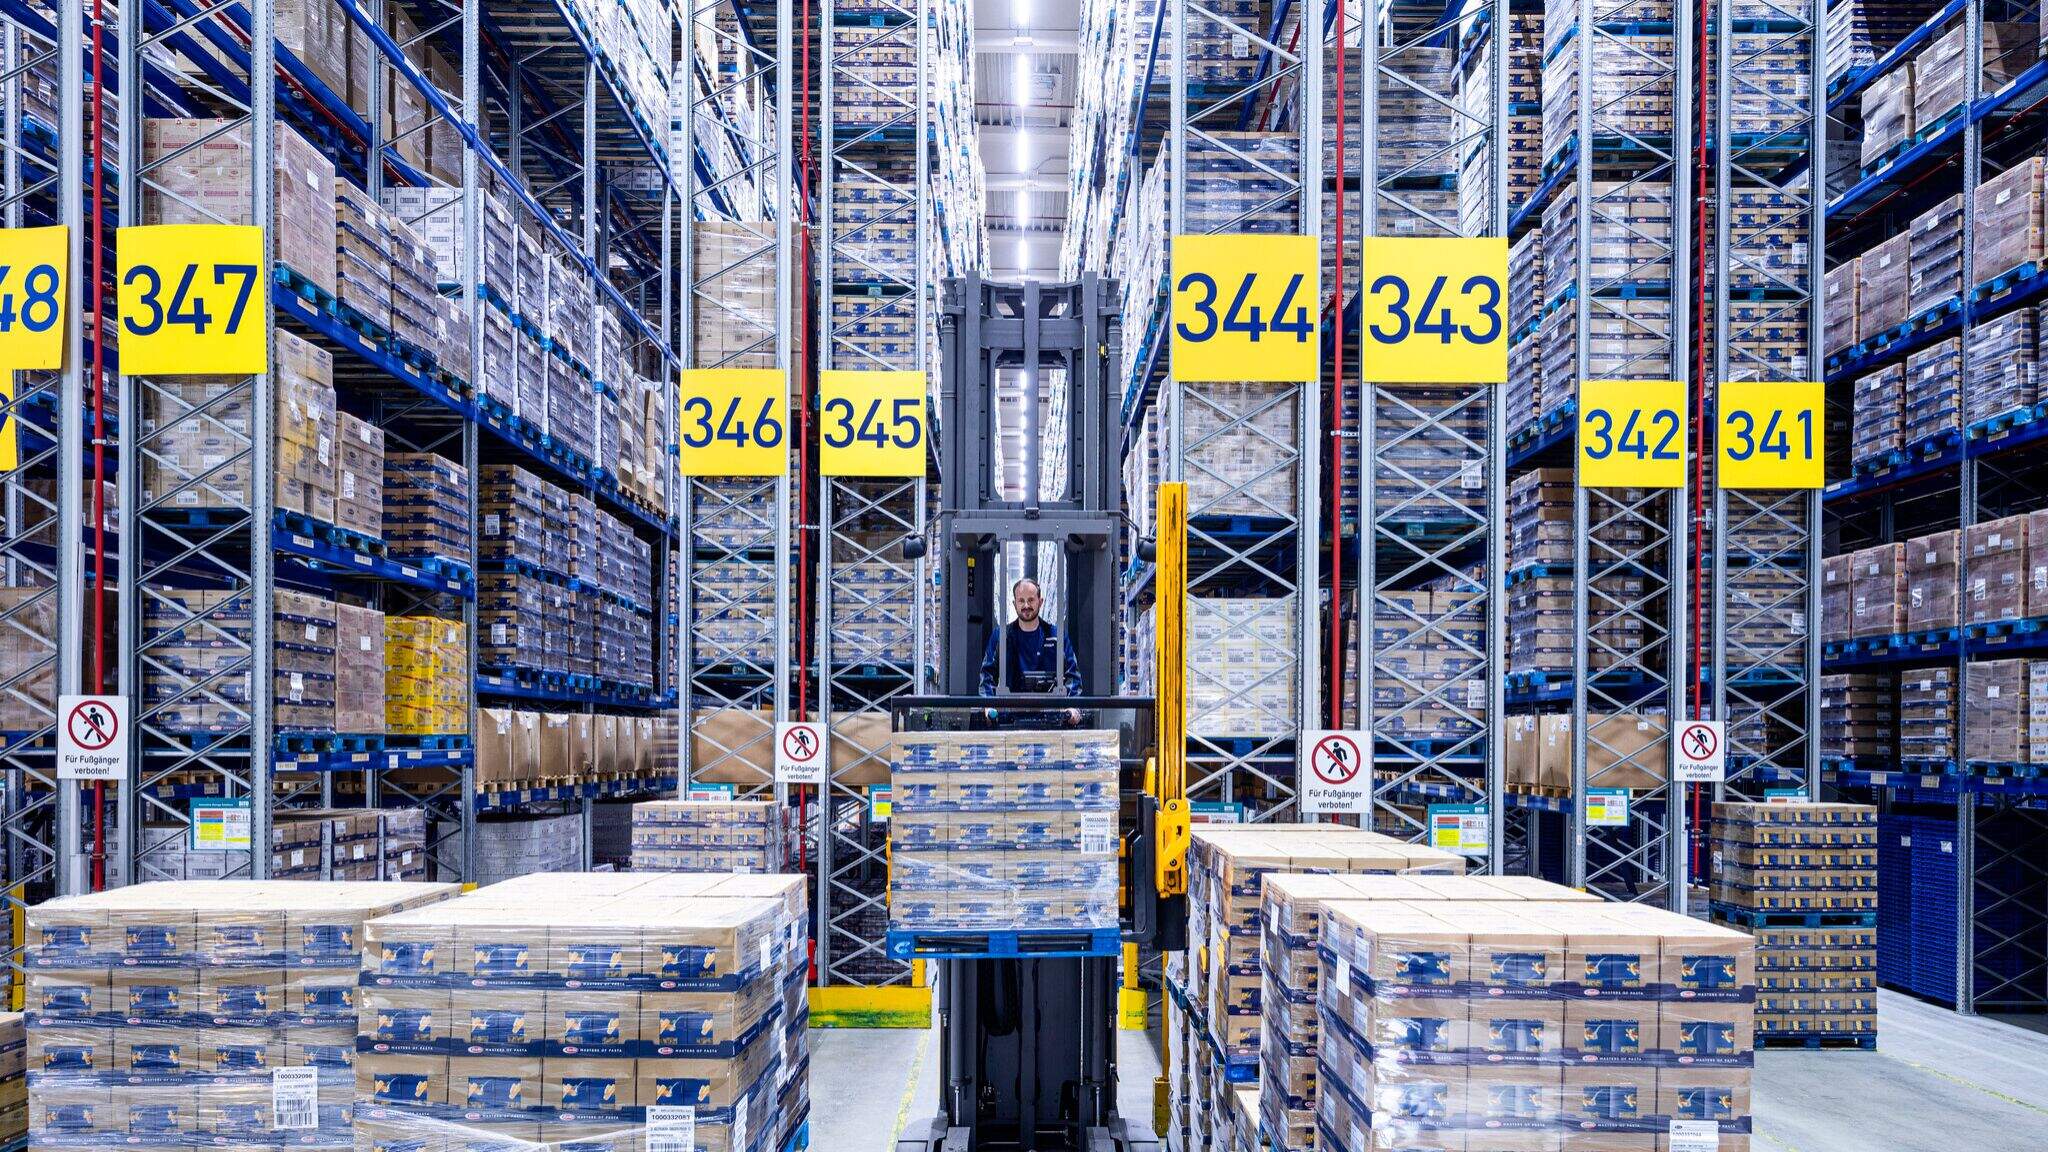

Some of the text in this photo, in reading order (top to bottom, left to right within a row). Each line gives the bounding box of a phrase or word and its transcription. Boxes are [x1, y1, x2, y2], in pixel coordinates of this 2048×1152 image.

[123, 263, 258, 336] 347
[1175, 272, 1315, 343] 344
[1368, 274, 1502, 345] 343
[683, 396, 783, 449] 346
[823, 397, 922, 449] 345
[1584, 408, 1680, 460] 342
[1726, 409, 1813, 461] 341
[65, 754, 120, 766] Für Fußgänger
[74, 767, 110, 775] verboten!
[1308, 789, 1363, 800] Für Fußgänger
[1317, 801, 1353, 809] verboten!
